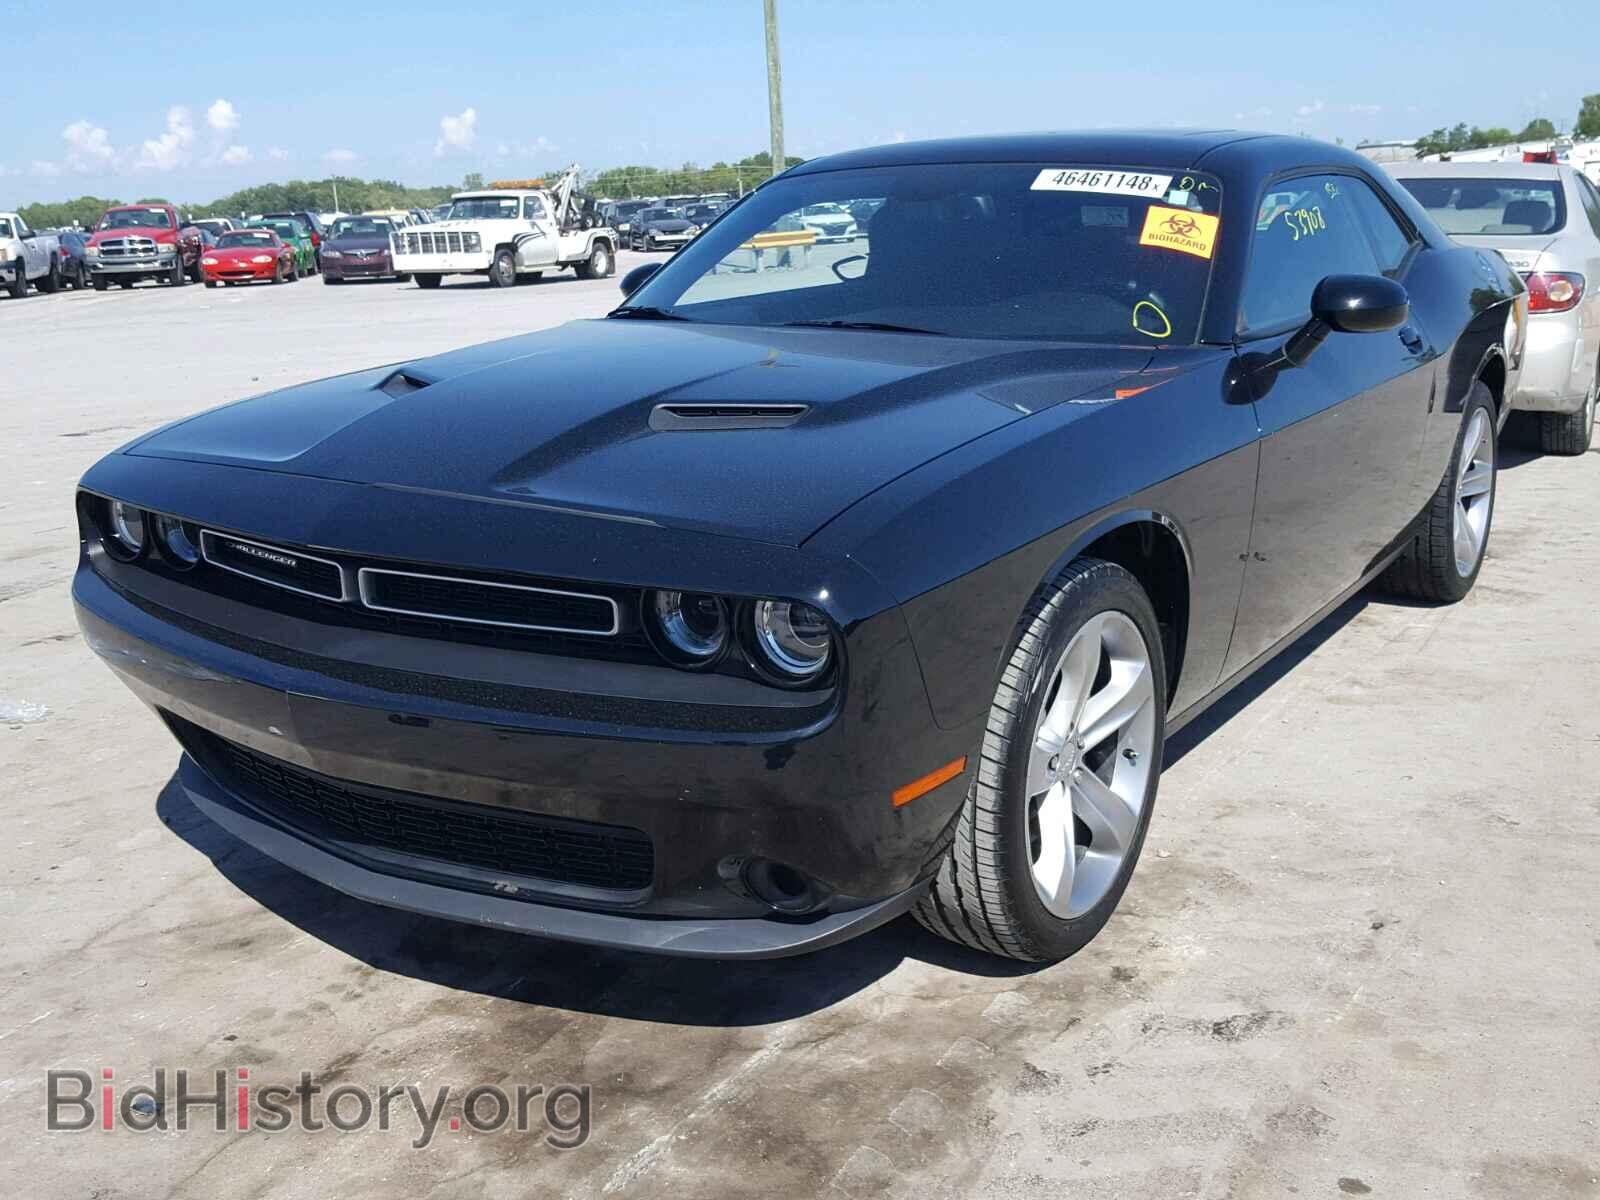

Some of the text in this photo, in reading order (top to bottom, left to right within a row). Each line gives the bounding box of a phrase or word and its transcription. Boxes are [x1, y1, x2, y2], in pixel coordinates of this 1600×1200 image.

[1052, 171, 1153, 191] 46461148
[1148, 233, 1207, 252] BIOHAZARD
[225, 542, 297, 566] CHALLENGER
